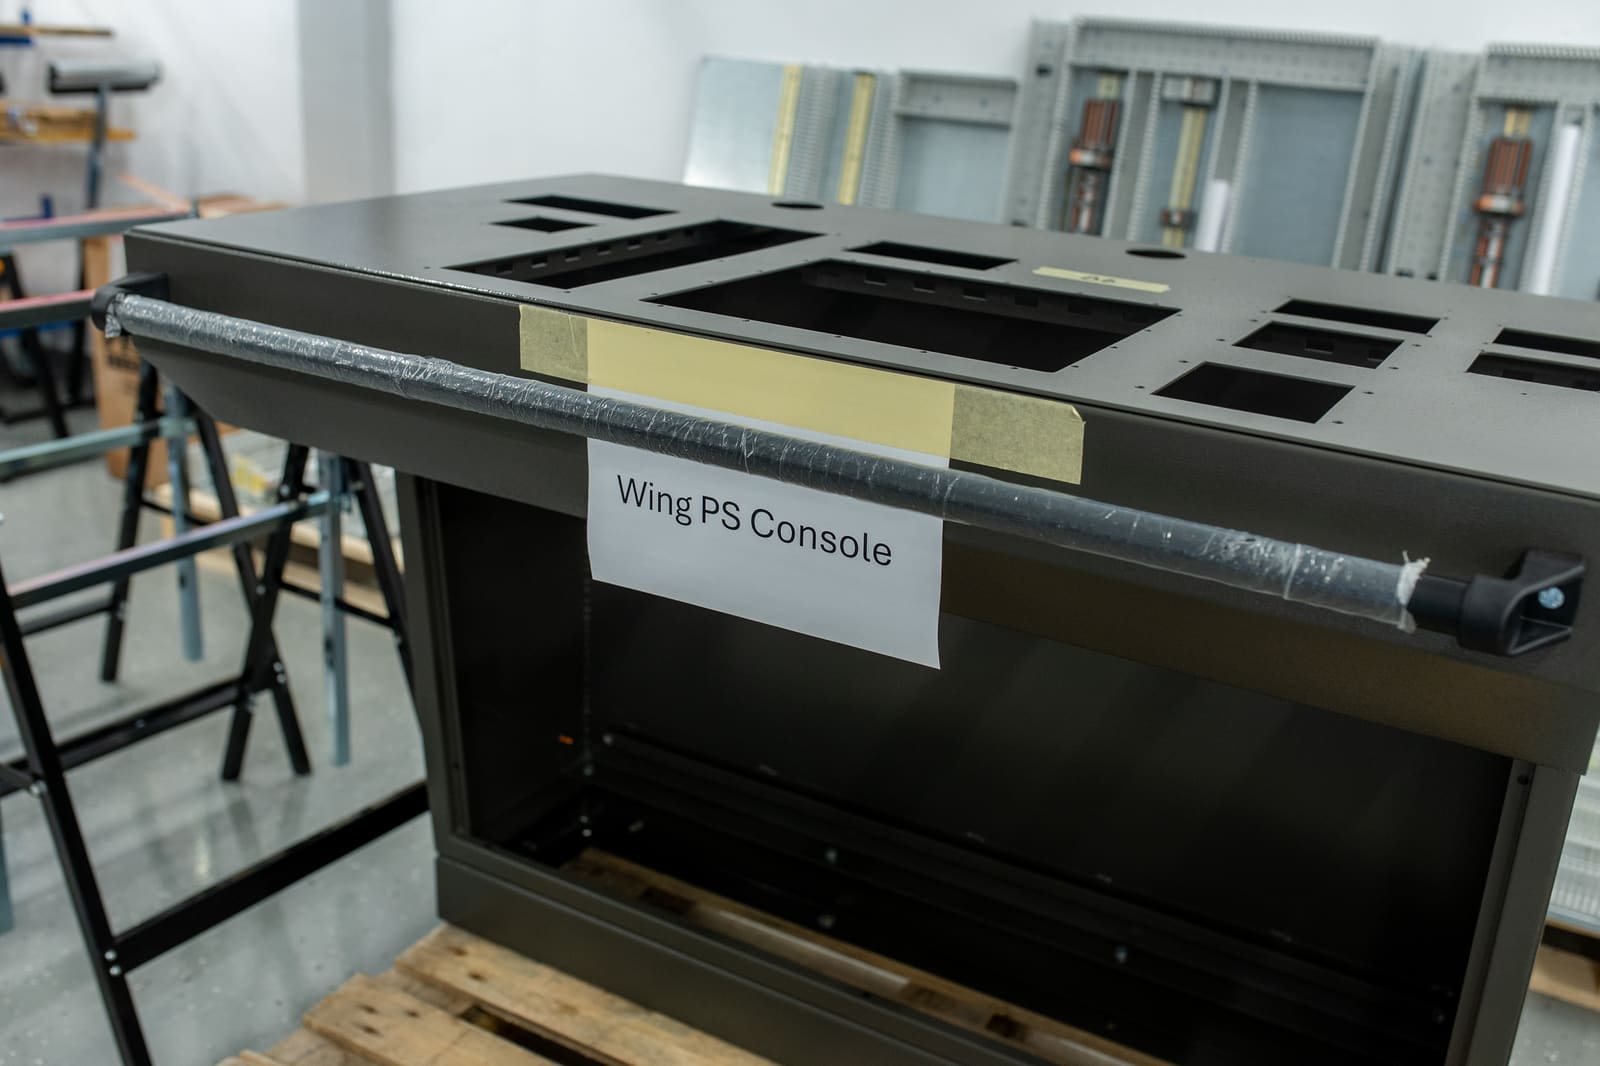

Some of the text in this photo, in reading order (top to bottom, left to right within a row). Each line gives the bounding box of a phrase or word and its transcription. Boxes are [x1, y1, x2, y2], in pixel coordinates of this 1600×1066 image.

[617, 474, 892, 566] Wing PS Console
